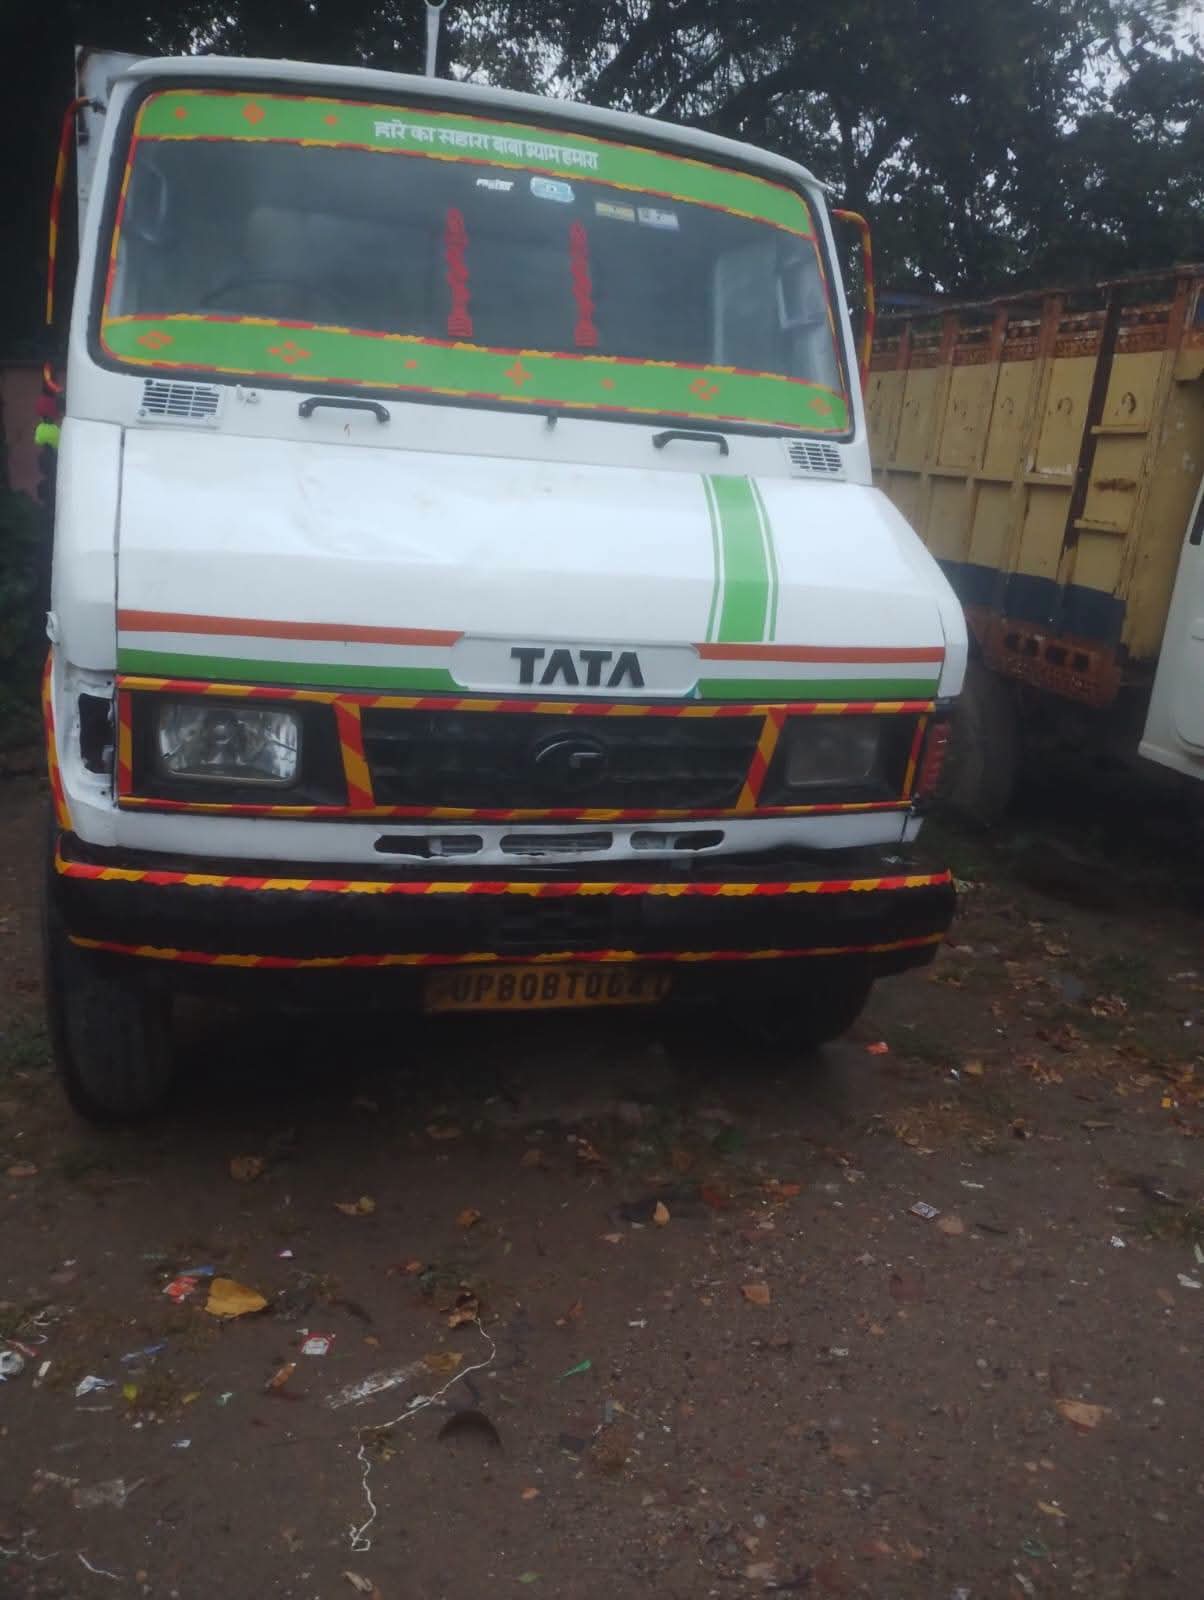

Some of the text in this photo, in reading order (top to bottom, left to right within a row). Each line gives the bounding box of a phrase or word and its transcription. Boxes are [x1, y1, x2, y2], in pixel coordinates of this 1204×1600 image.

[410, 126, 436, 143] का
[439, 129, 490, 151] सहारा
[492, 136, 522, 157] बाबा
[511, 647, 645, 688] TATA
